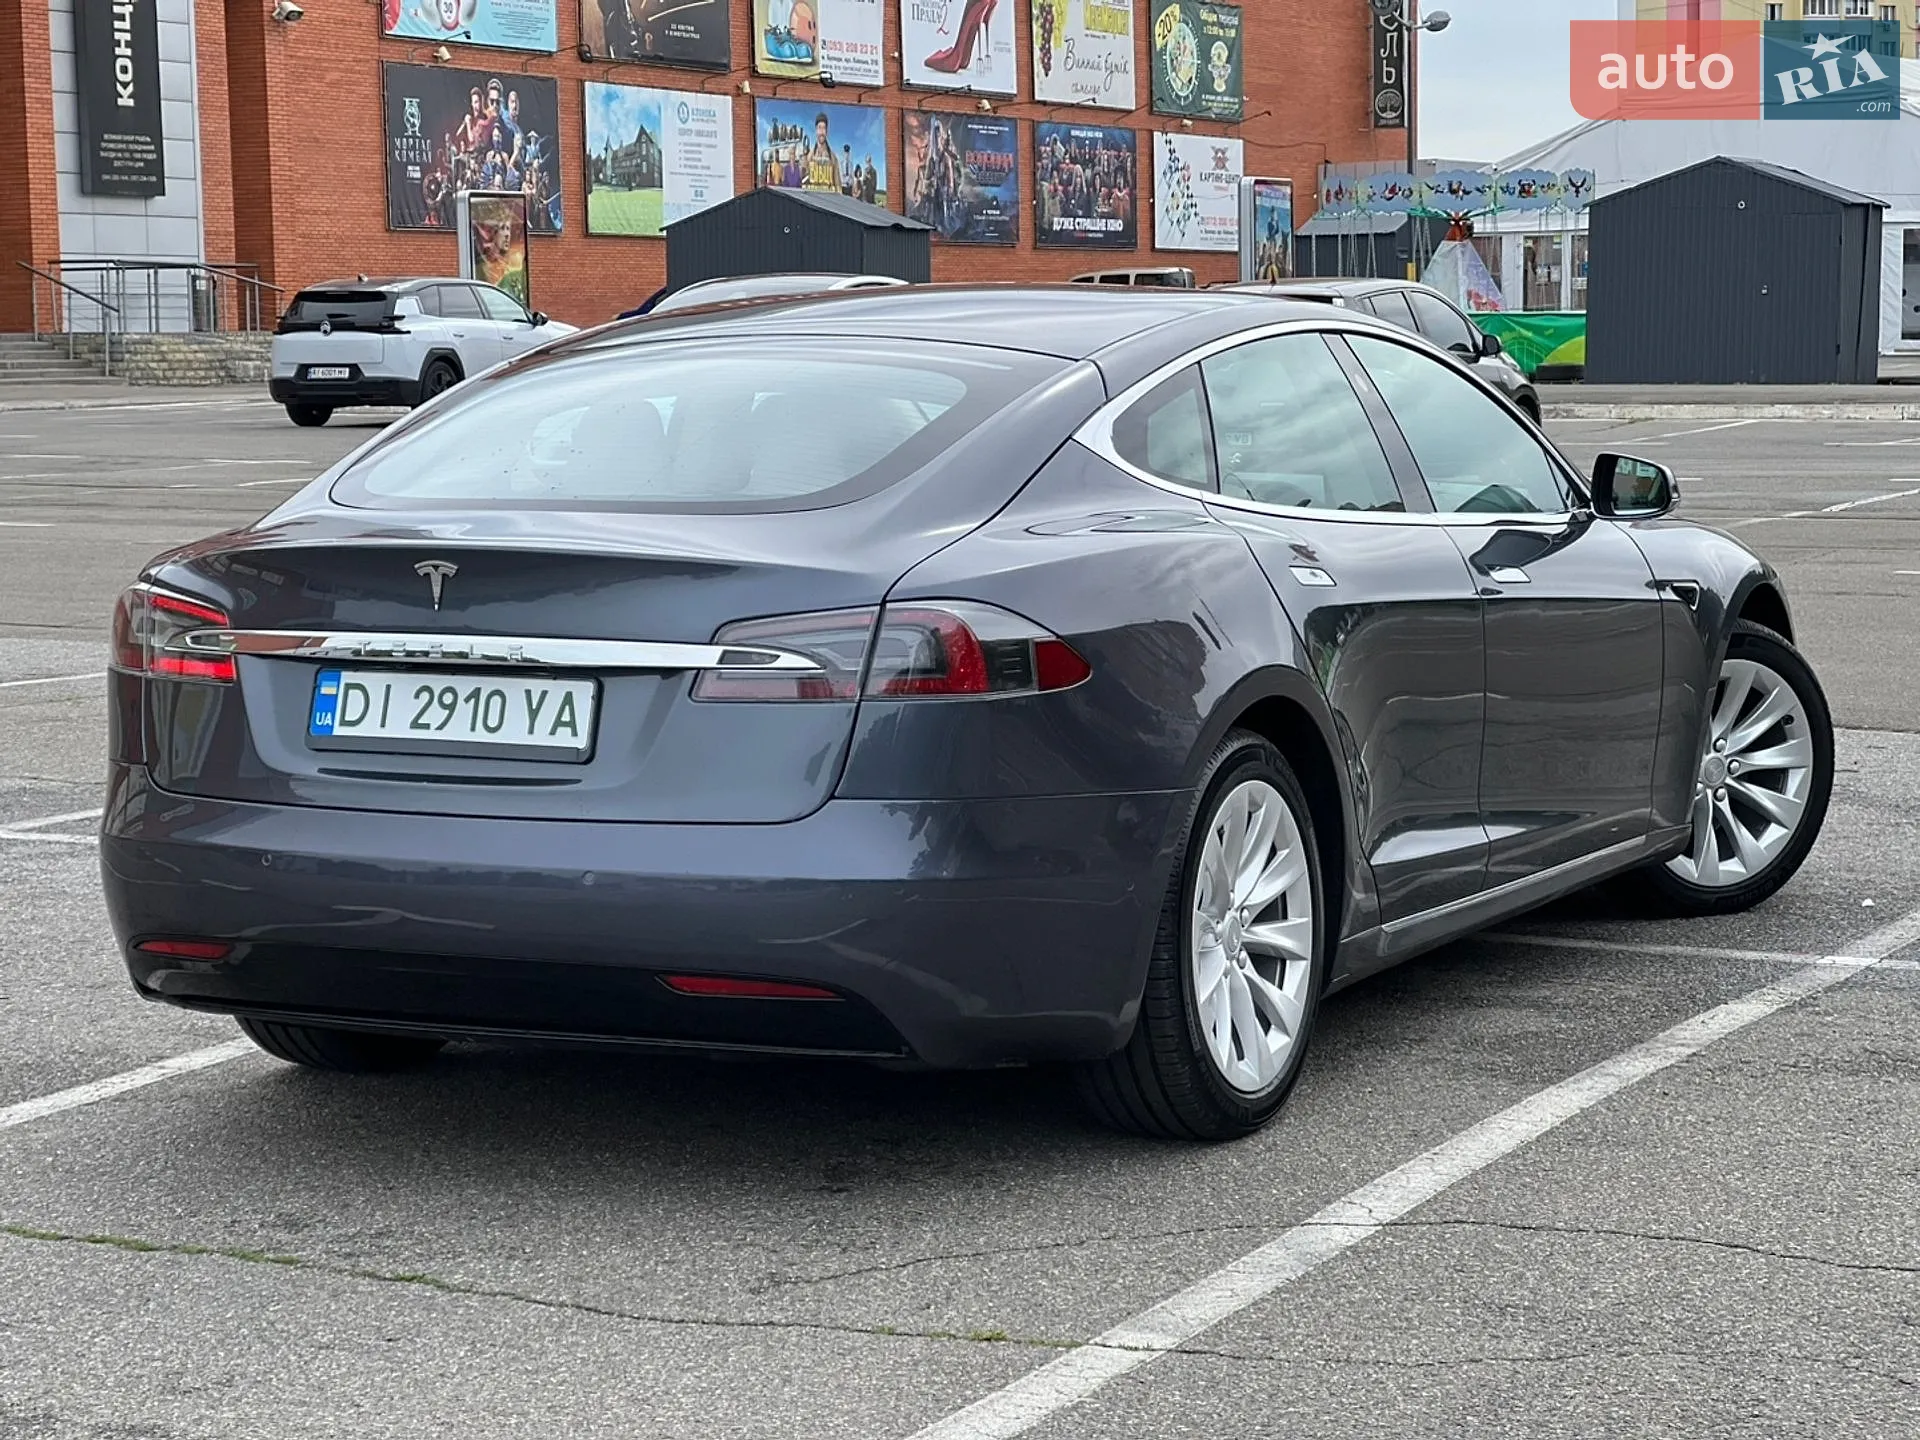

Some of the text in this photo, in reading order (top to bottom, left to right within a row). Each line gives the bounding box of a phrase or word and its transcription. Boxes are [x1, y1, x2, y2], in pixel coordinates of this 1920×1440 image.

[113, 0, 134, 107] КОНЦ
[316, 712, 332, 726] UA
[339, 682, 579, 738] DI 2910 YA
